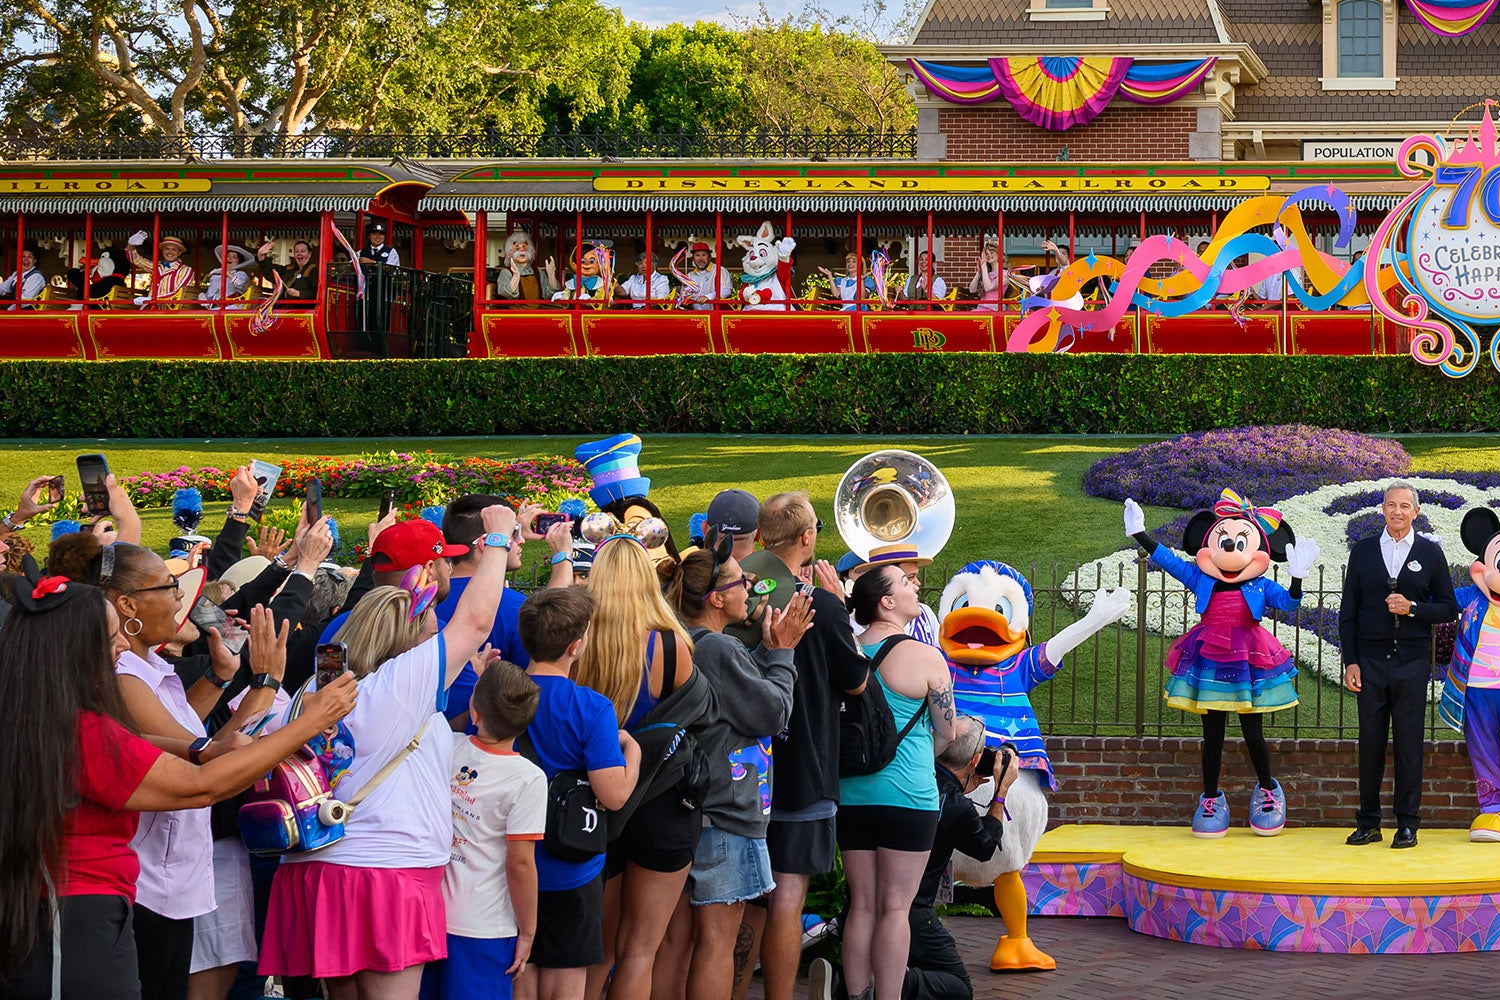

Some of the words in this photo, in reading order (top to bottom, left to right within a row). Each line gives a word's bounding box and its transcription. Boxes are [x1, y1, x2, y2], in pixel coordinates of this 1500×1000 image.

[1314, 147, 1394, 158] POPULATION
[626, 179, 919, 188] DISNEYLAND
[991, 179, 1237, 188] RAILROAD
